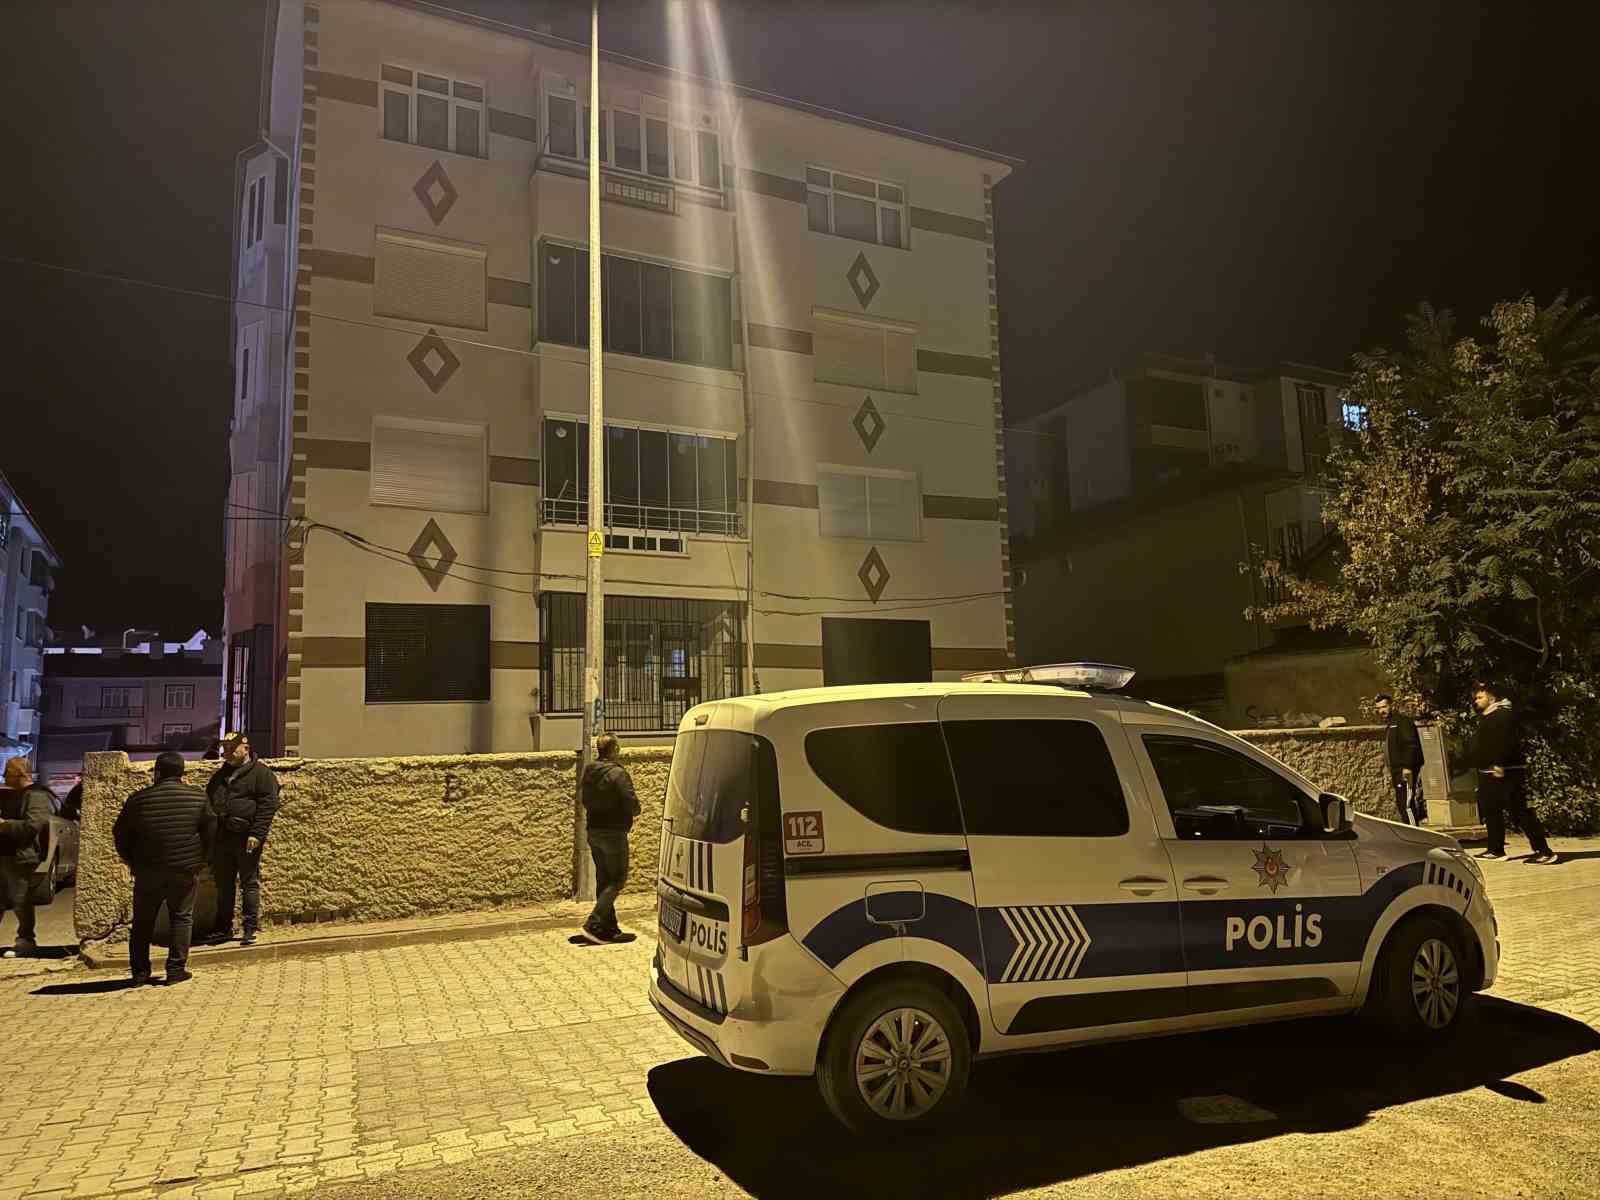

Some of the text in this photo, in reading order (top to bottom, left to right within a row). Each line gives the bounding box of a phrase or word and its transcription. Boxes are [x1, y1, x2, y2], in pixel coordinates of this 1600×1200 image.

[788, 816, 818, 837] 112
[690, 919, 727, 954] POLİS
[1225, 903, 1323, 951] POLİS
